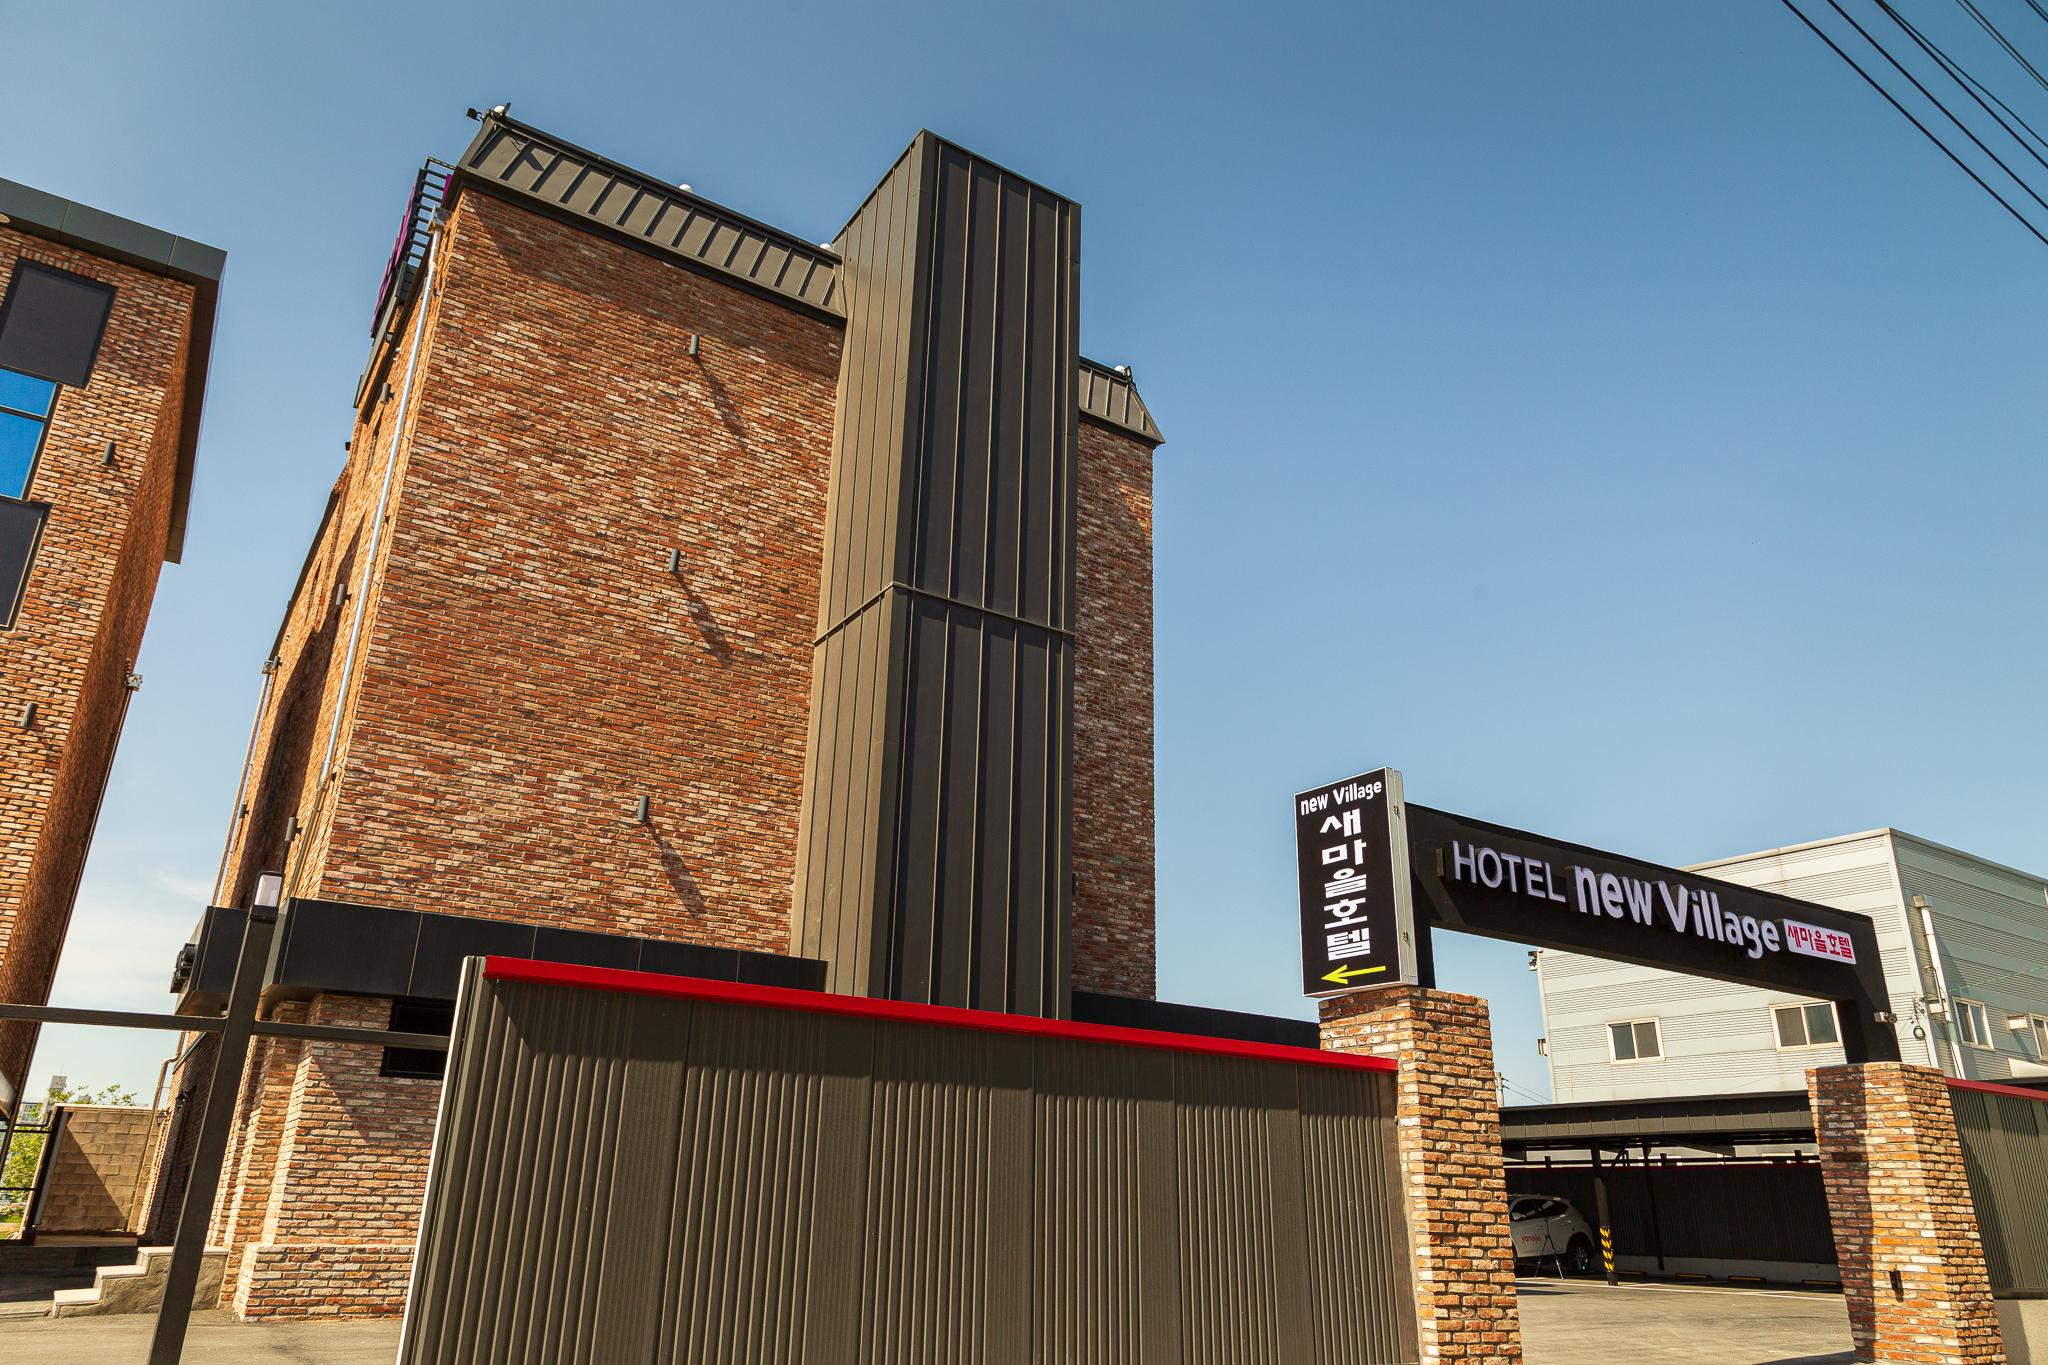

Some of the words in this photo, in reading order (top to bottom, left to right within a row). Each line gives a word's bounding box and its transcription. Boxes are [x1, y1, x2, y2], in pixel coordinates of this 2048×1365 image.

[1301, 793, 1328, 816] new
[1333, 781, 1382, 805] Village
[1319, 808, 1371, 961] 새마을호텔
[1453, 840, 1566, 903] HOTEL
[1574, 865, 1652, 926] new
[1658, 880, 1780, 960] Village
[1787, 924, 1853, 959] 새마을호텔
